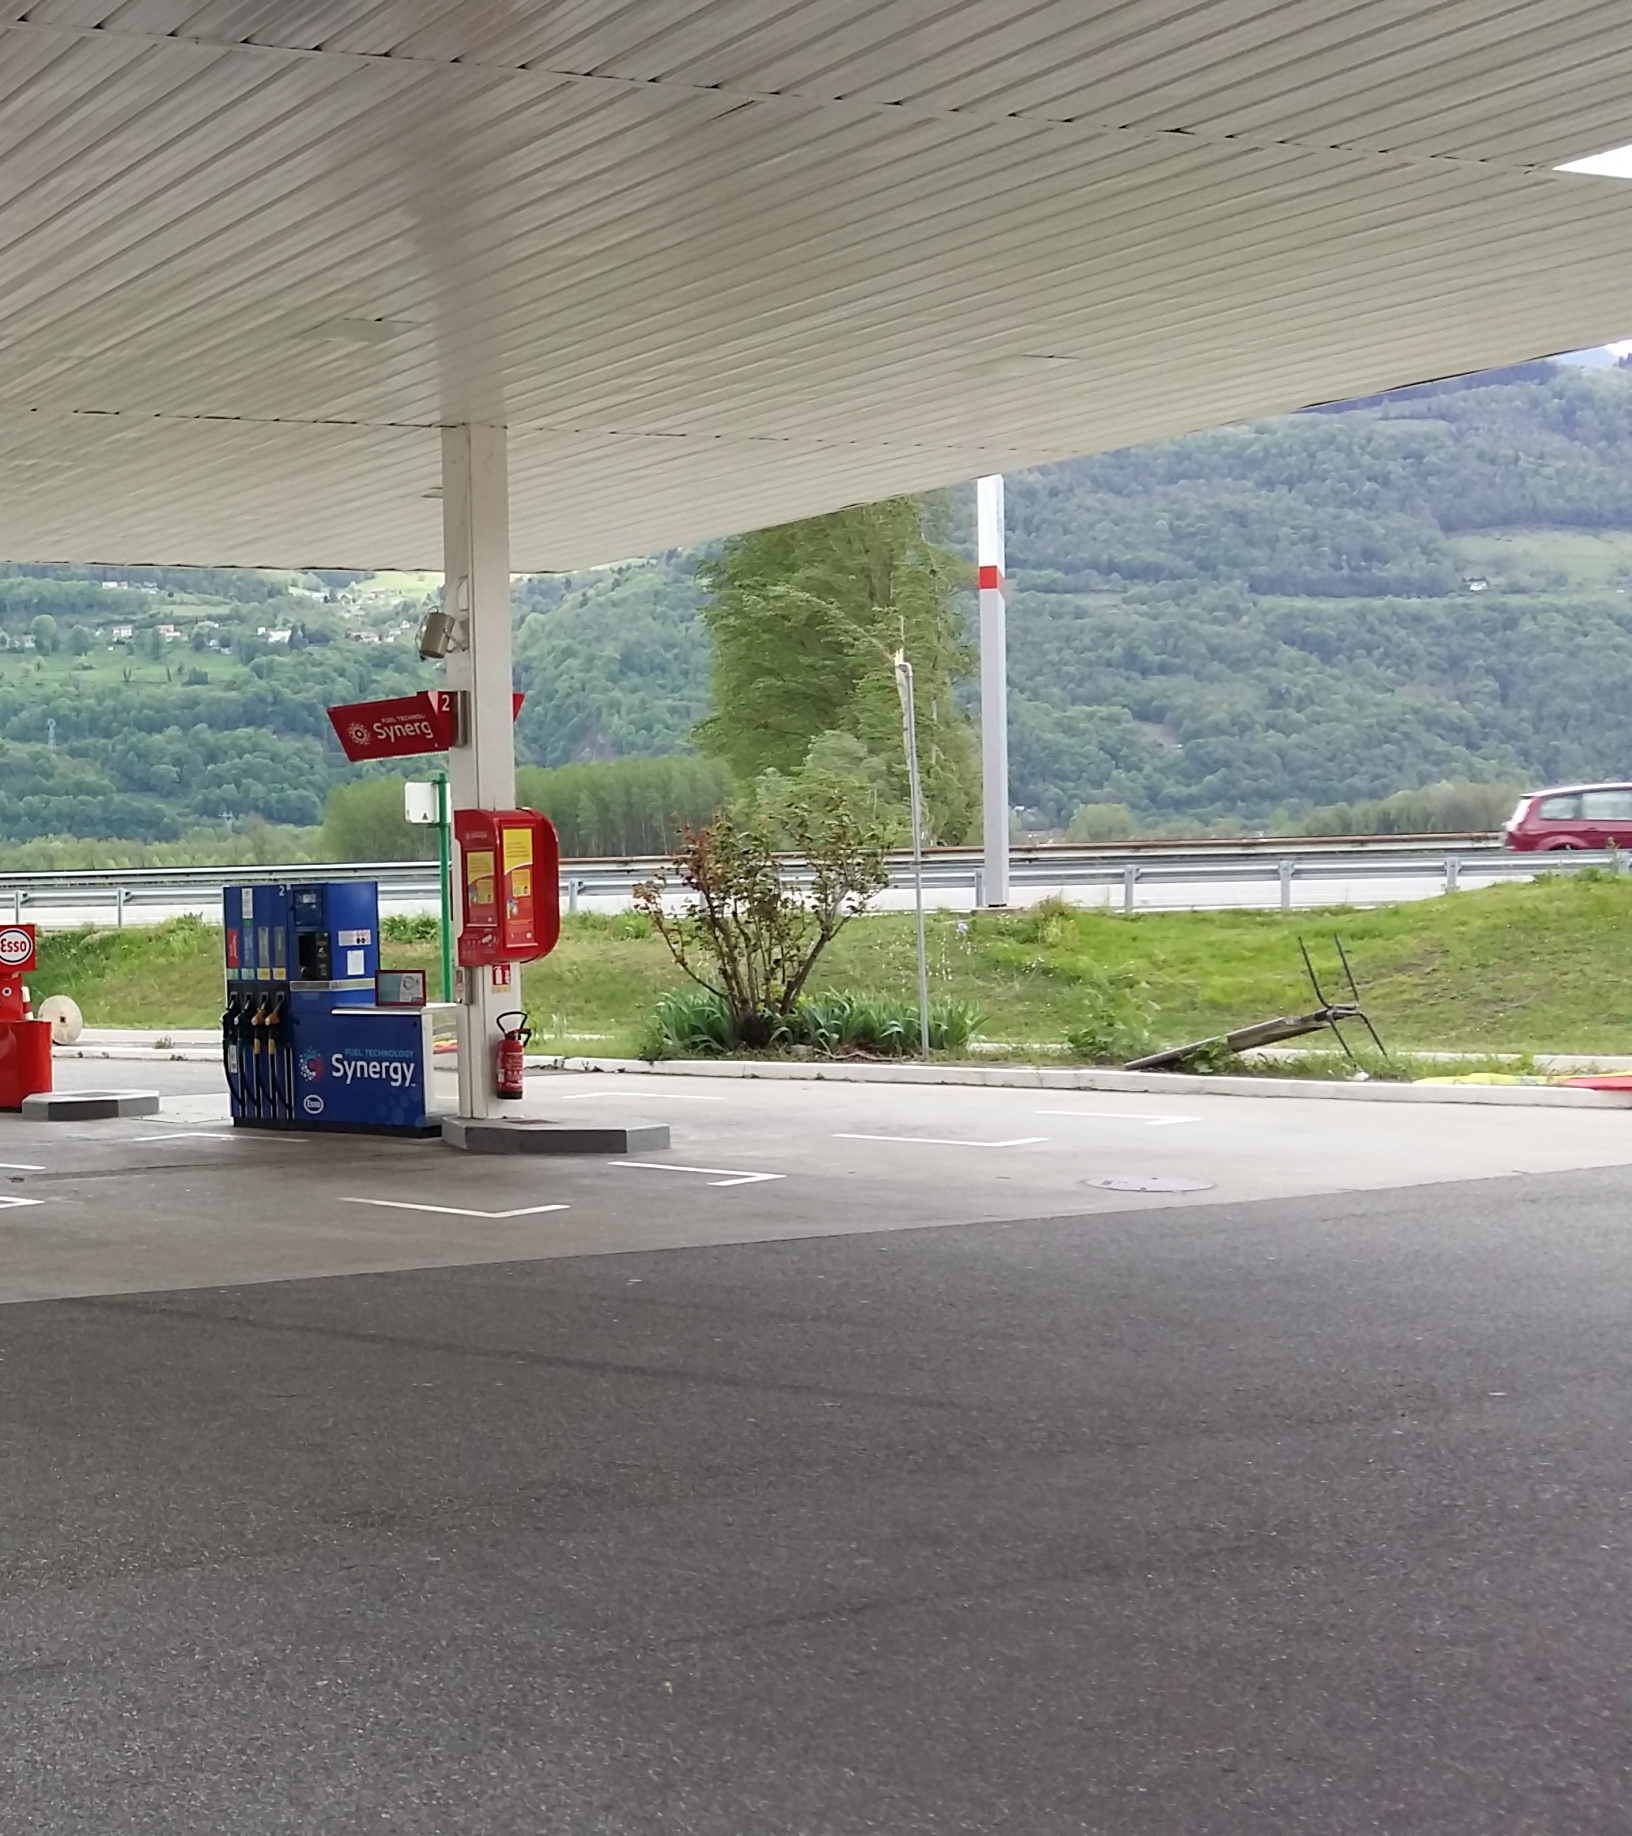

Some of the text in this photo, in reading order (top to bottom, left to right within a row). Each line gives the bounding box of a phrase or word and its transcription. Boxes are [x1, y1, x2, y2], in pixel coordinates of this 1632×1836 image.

[441, 694, 450, 711] 2
[373, 721, 434, 742] Synerg
[279, 886, 285, 896] 2
[0, 938, 27, 953] Esso
[345, 1049, 414, 1058] FUEL TECHNOLOGY
[331, 1053, 415, 1087] Synergy
[307, 1099, 321, 1108] Esso
